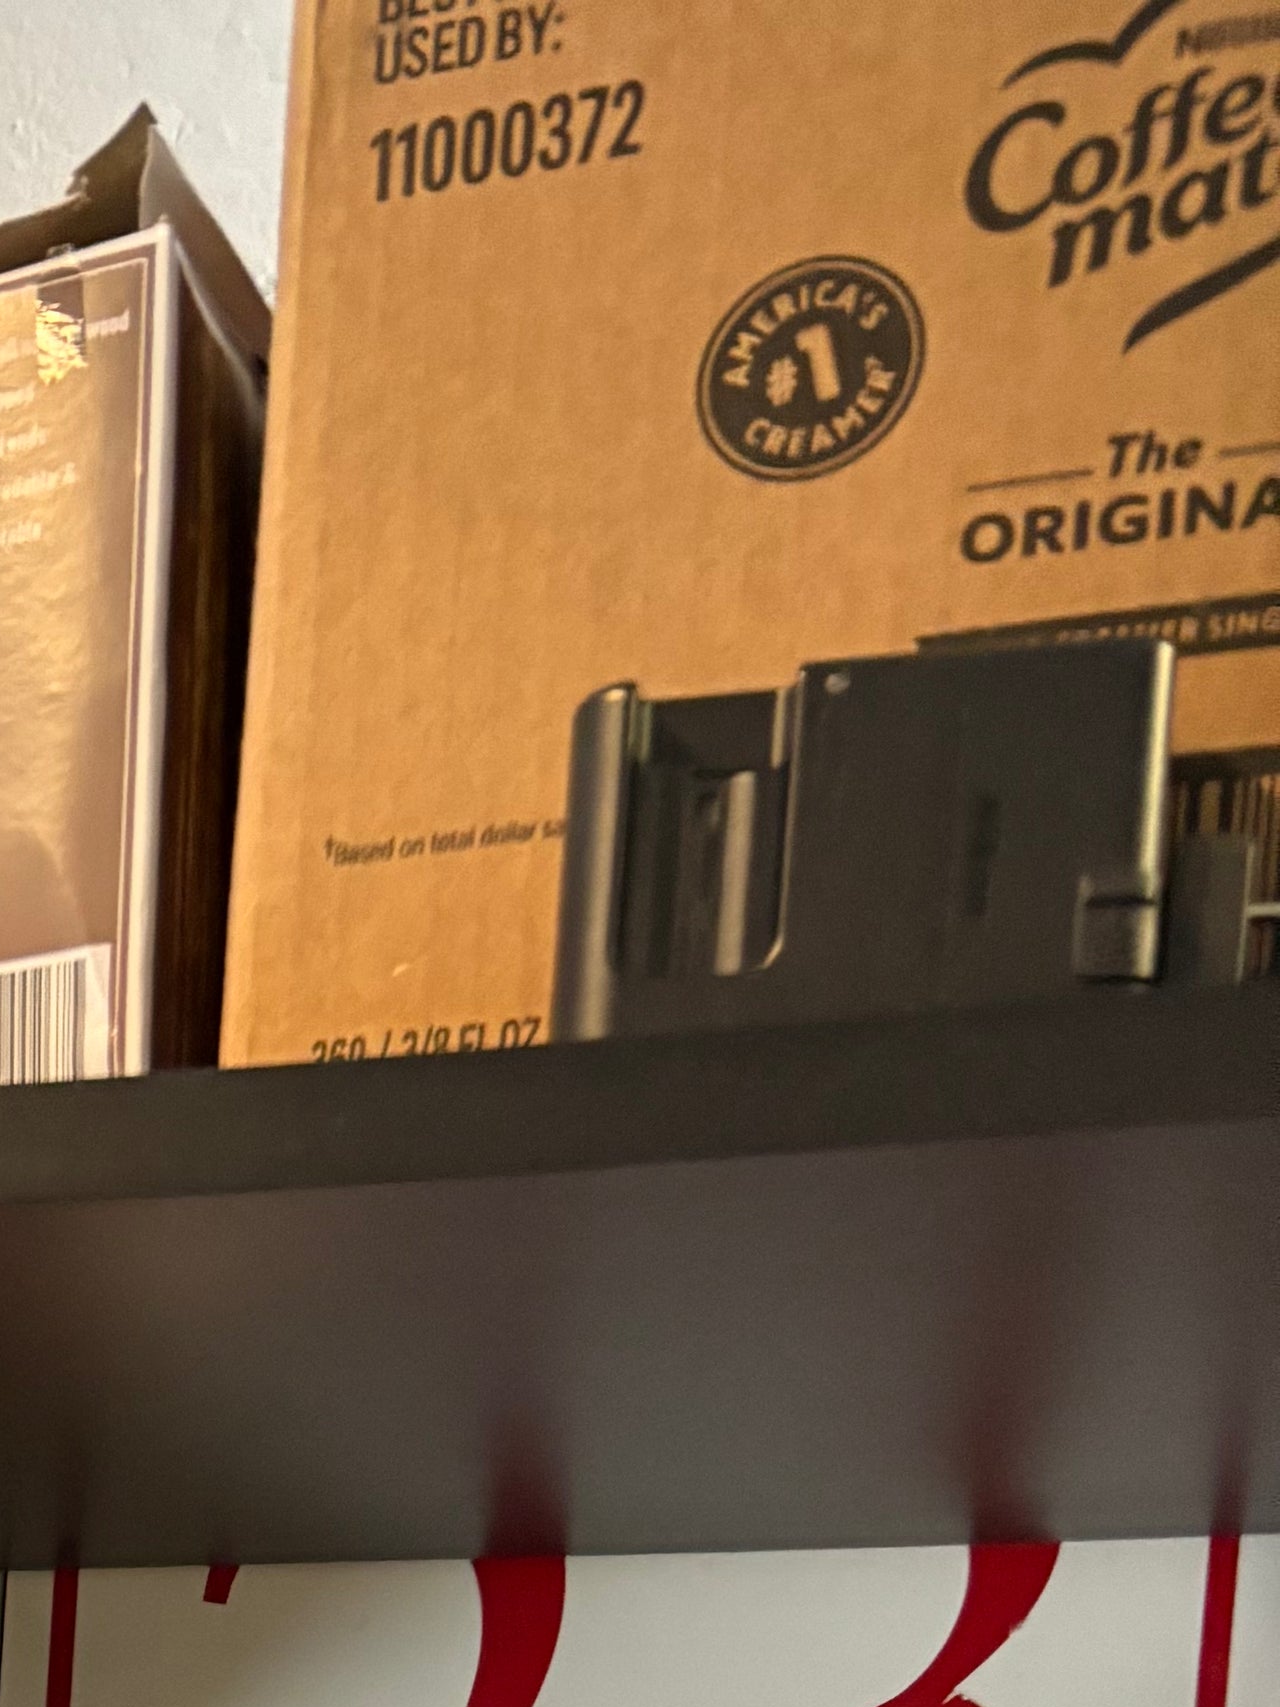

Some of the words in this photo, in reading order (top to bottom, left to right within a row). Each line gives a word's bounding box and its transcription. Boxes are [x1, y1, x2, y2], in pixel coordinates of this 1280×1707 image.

[373, 15, 487, 85] USED
[495, 2, 568, 62] BY:
[370, 79, 645, 202] 11000372
[963, 65, 1280, 234] Coffe
[722, 278, 889, 388] AMERICA'S
[765, 321, 841, 408] #1
[742, 366, 896, 459] CREAMER
[1106, 430, 1204, 480] The
